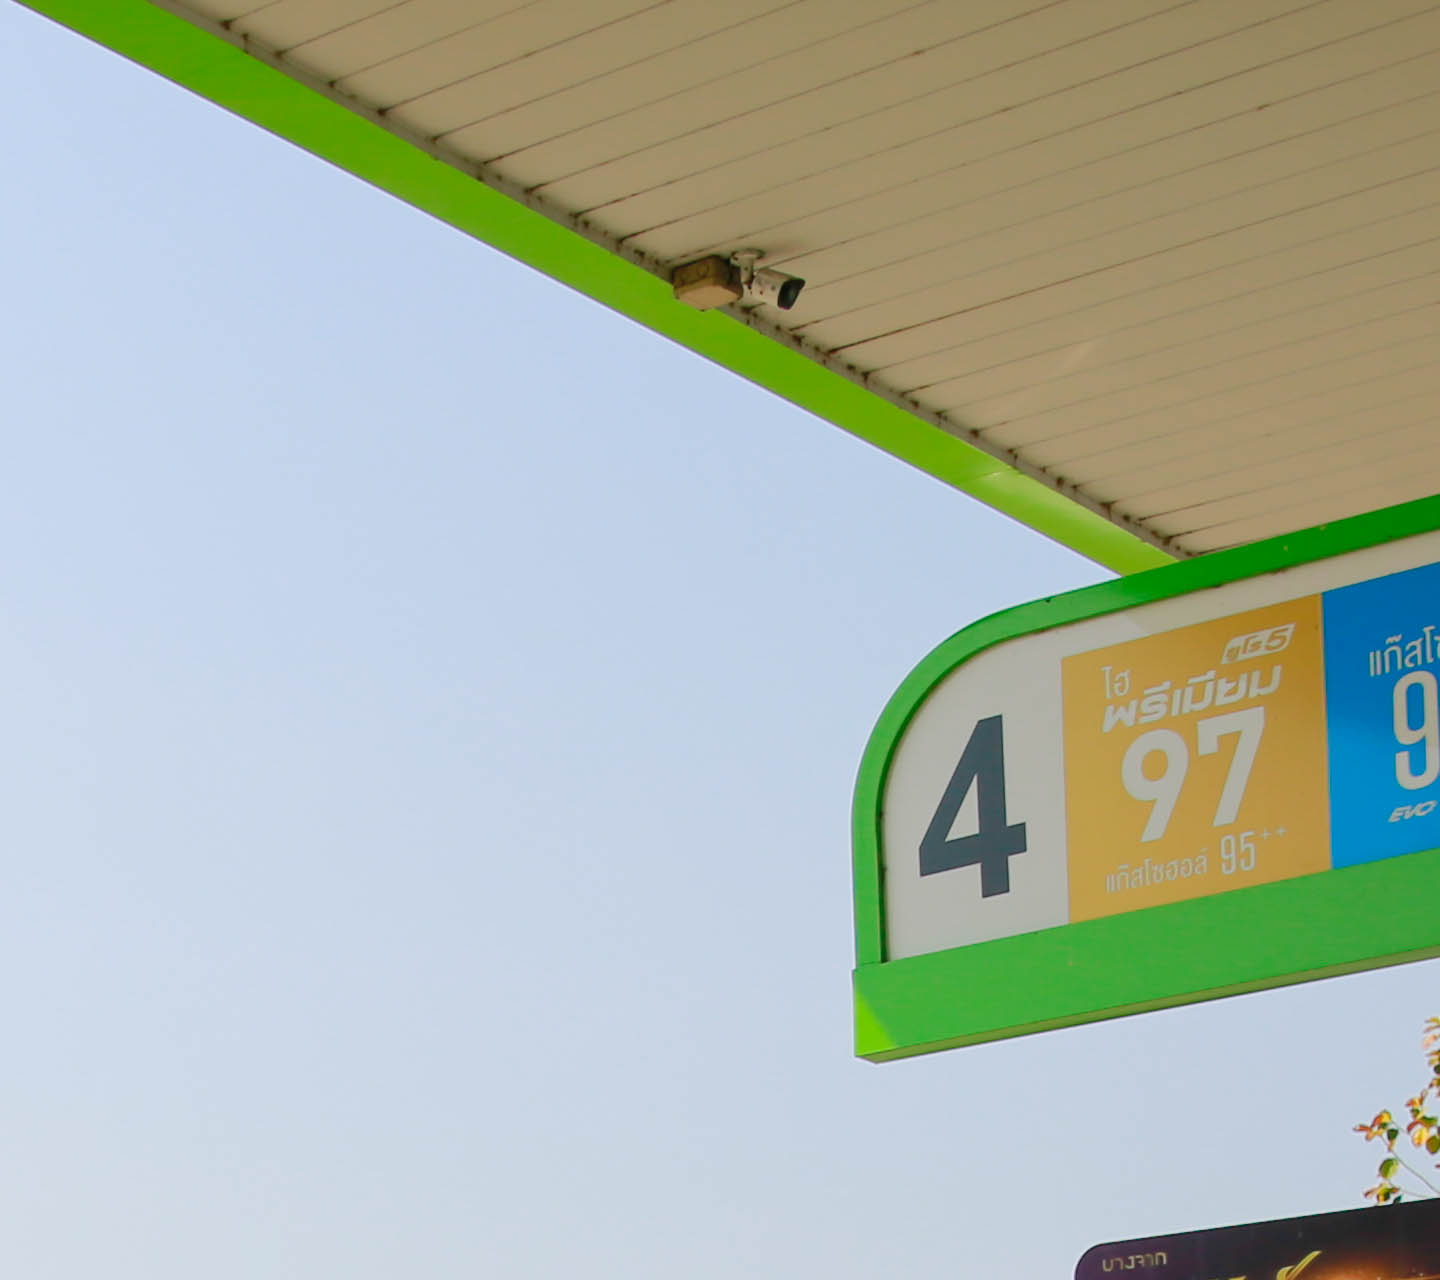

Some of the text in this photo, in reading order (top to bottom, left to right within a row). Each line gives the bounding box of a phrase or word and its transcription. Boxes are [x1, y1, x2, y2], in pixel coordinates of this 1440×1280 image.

[1101, 665, 1131, 700] ไฮ
[1101, 665, 1283, 733] พรีเมียม
[1122, 706, 1265, 843] 97
[919, 714, 1027, 898] 4
[1388, 800, 1437, 823] EVO
[1102, 1251, 1167, 1272] บางจาก
